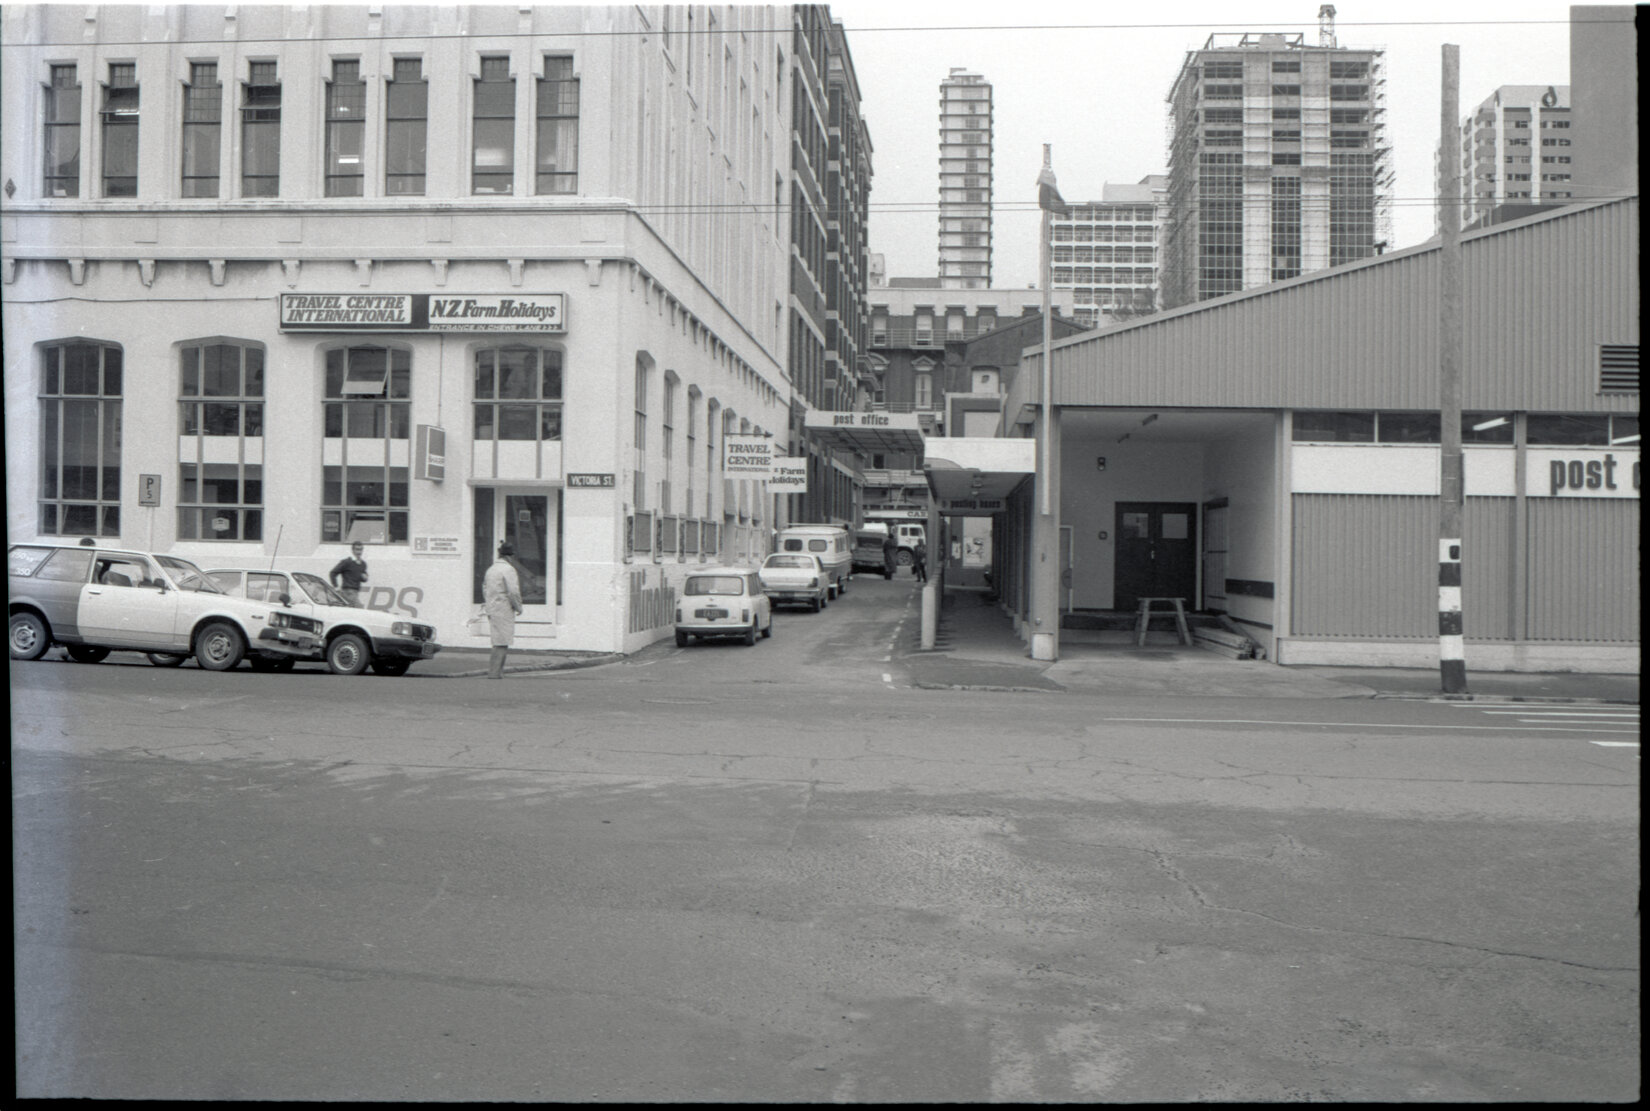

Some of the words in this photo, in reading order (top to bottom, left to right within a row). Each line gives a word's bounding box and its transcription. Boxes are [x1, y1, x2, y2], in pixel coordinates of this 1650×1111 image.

[286, 296, 342, 309] TRAVEL
[346, 296, 405, 309] CENTRE
[286, 309, 405, 322] INTERNATIONAL
[496, 299, 556, 322] Holidays
[833, 413, 854, 426] post
[861, 413, 889, 426] office
[728, 443, 771, 454] TRAVEL
[728, 456, 771, 466] CENTRE
[780, 467, 805, 475] Farm
[1549, 453, 1618, 497] post
[146, 477, 154, 489] P
[570, 475, 601, 486] VICTORIA
[146, 490, 153, 499] 5
